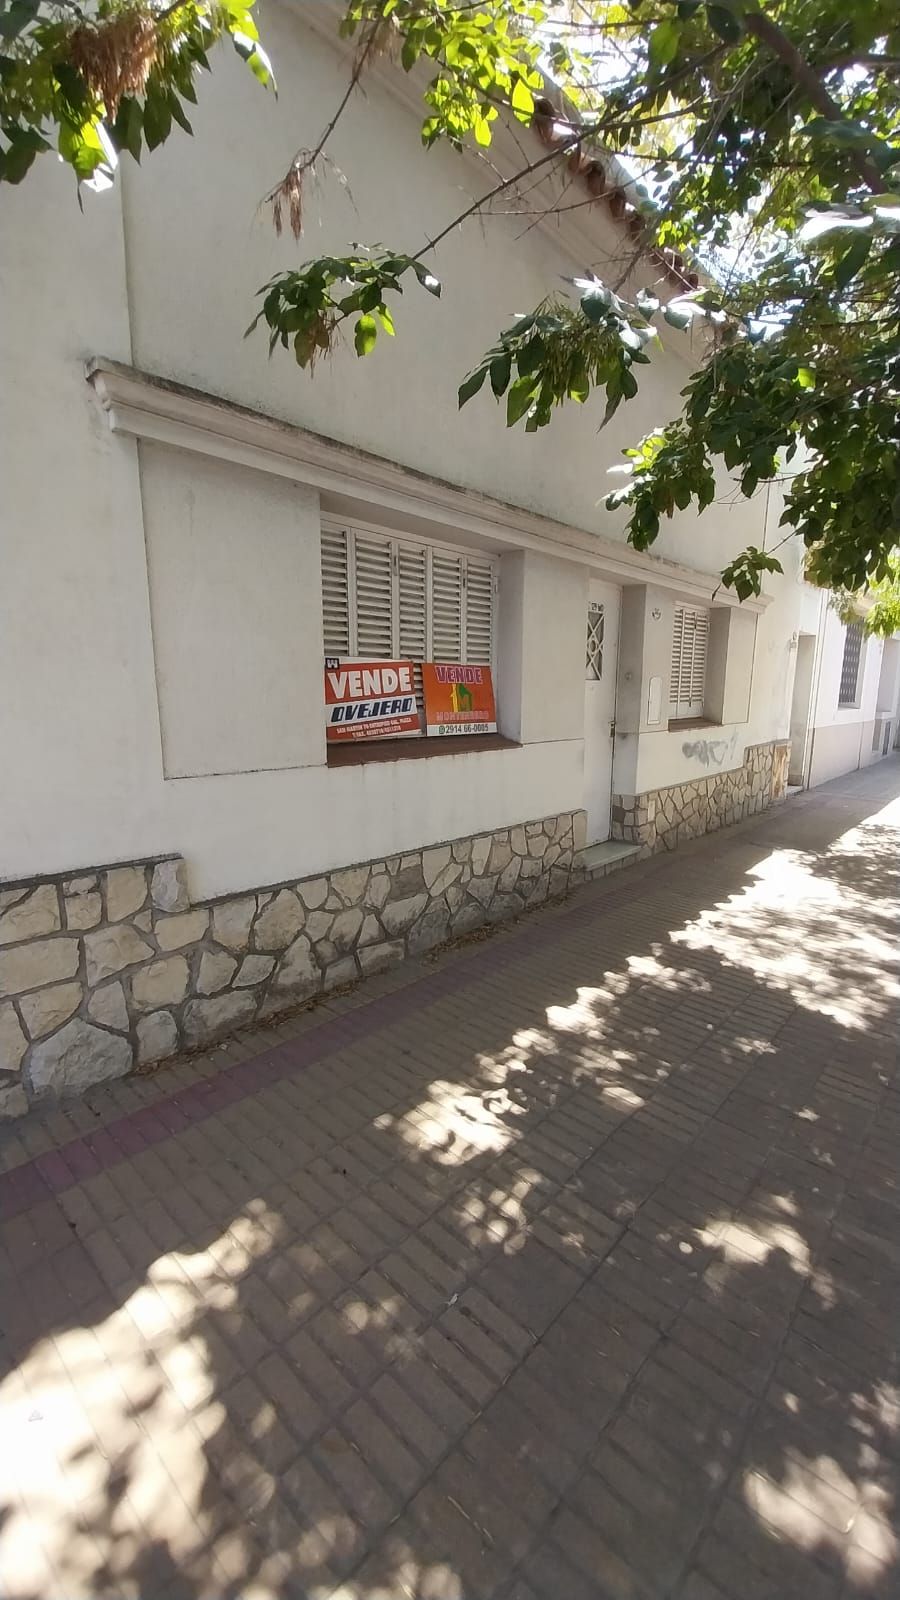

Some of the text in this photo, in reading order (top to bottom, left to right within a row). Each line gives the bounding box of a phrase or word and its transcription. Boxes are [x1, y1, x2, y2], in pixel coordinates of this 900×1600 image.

[327, 666, 412, 699] VENDE
[434, 665, 484, 685] VENDE
[331, 697, 413, 723] OVEJERO
